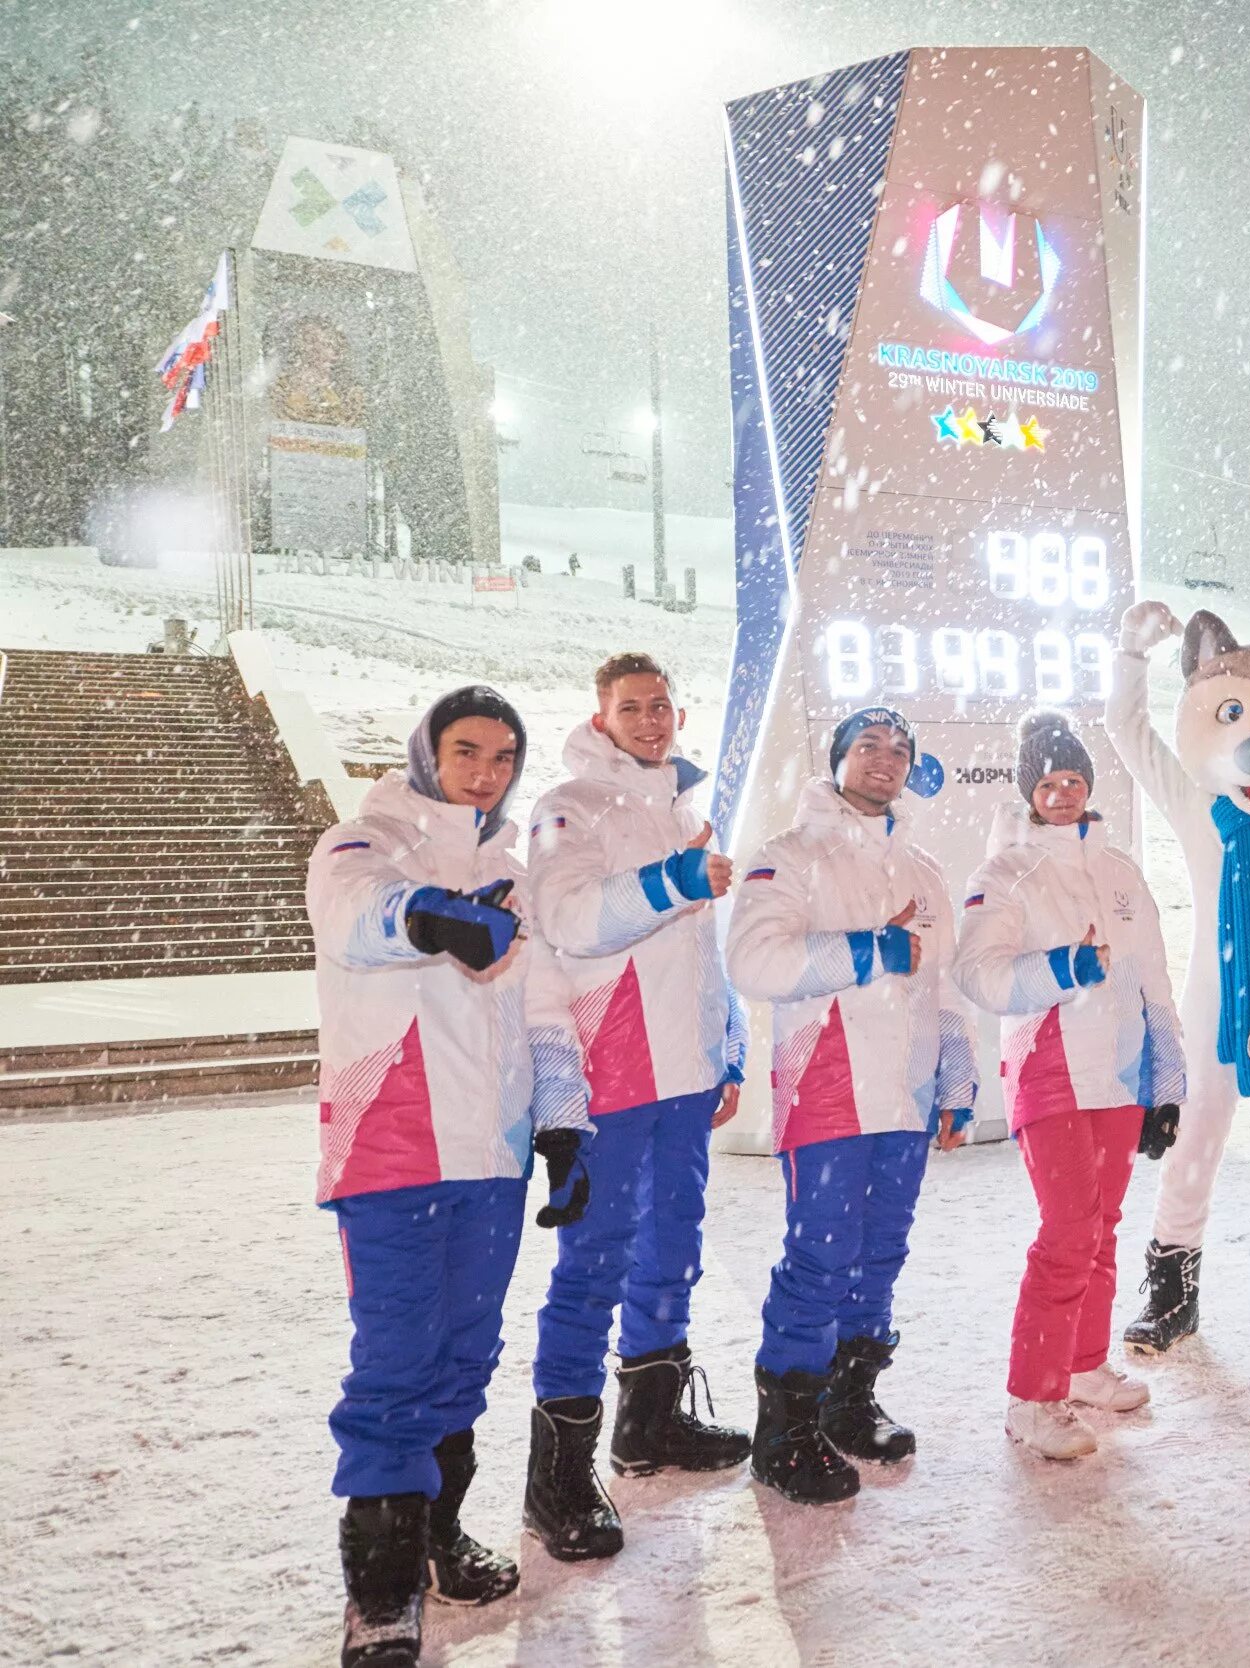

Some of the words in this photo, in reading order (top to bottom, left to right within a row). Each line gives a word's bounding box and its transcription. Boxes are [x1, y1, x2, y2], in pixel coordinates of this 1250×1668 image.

[877, 342, 1049, 387] KRASNOYARSK
[1050, 366, 1099, 393] 2019
[925, 376, 986, 399] WINTER
[990, 384, 1090, 412] UNIVERSIADE
[956, 767, 1015, 784] НОРН
